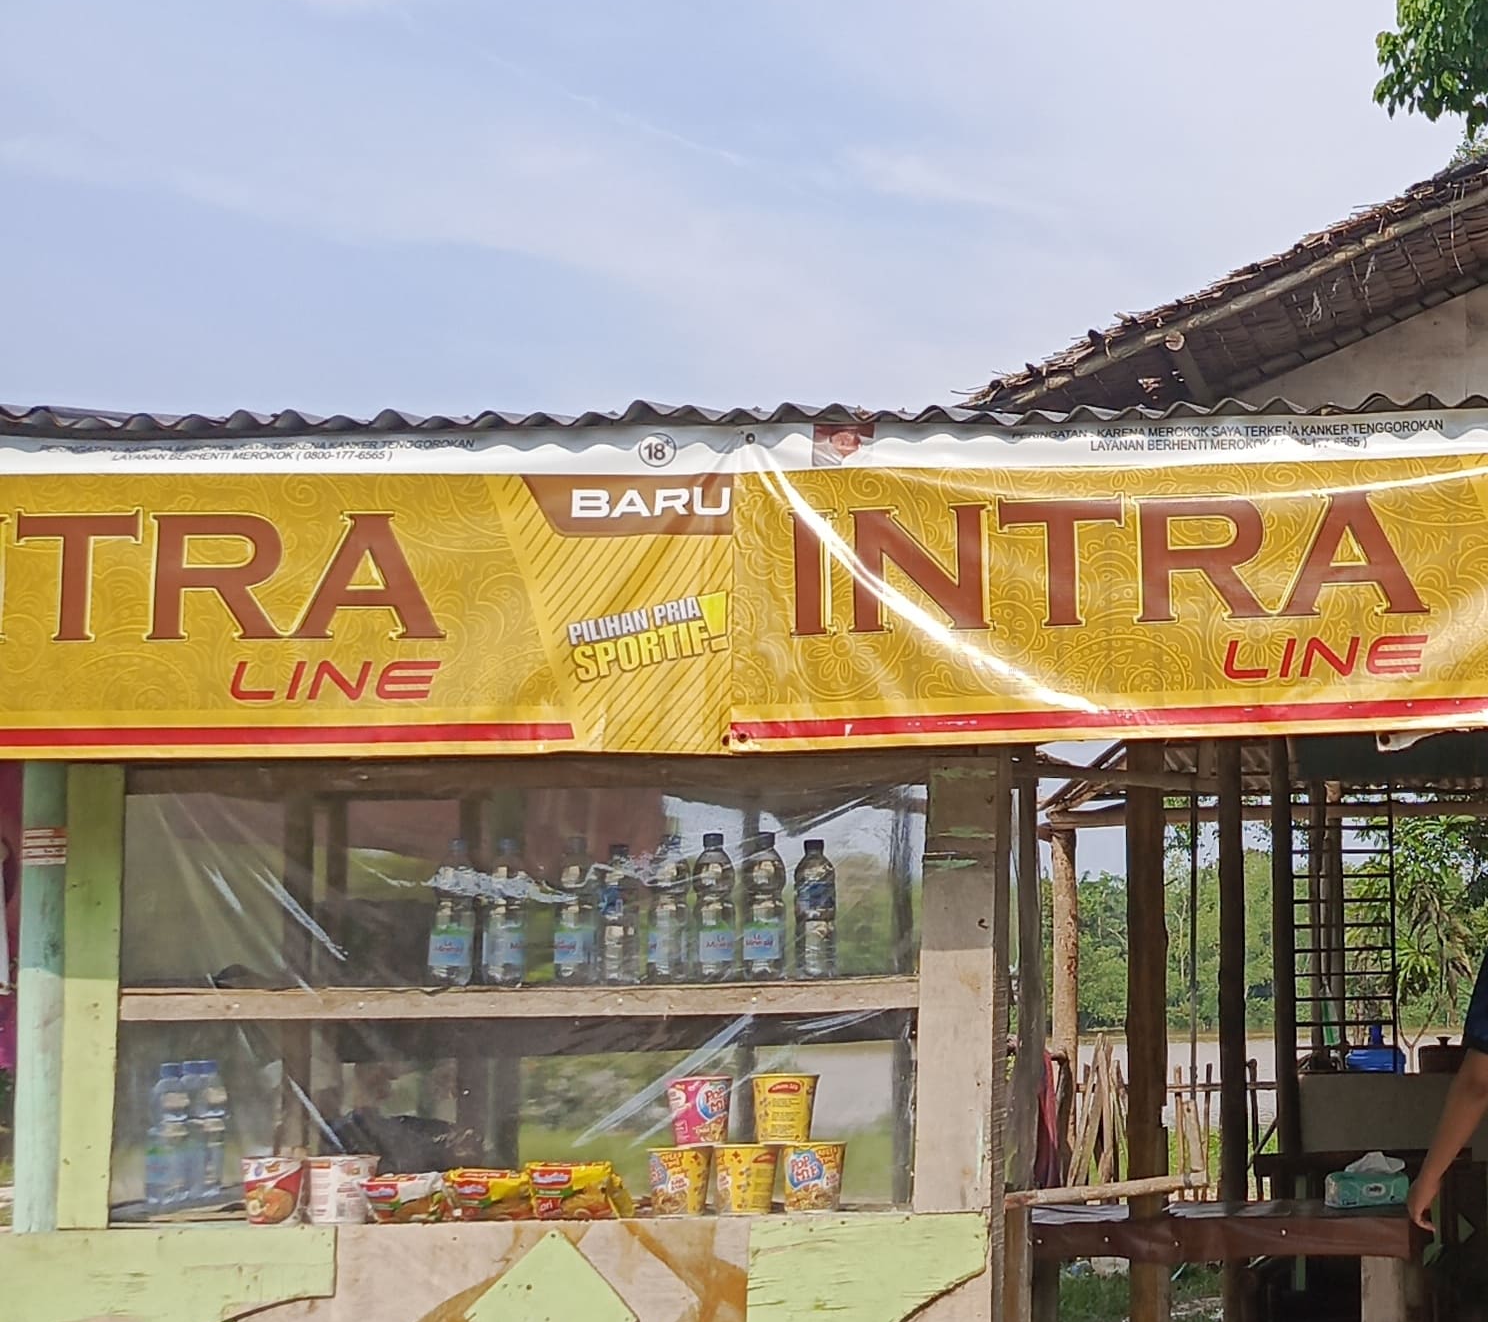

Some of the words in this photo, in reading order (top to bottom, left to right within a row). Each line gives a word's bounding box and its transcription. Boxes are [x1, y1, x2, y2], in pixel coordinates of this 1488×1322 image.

[1090, 440, 1144, 451] LAYANAN
[1147, 439, 1207, 451] BERHENTI
[1097, 428, 1145, 438] KARENA
[1212, 425, 1241, 437] SAYA
[1301, 423, 1349, 435] KANKER
[1351, 420, 1443, 434] TENGGOROKAN
[231, 451, 293, 460] MEROKOK
[571, 487, 731, 518] BARU
[0, 508, 447, 642] TRA
[789, 491, 1431, 637] INTRA
[568, 608, 650, 646] PILIHAN
[653, 596, 703, 626] PRIA
[1223, 634, 1431, 680] LINE
[229, 660, 442, 701] LINE
